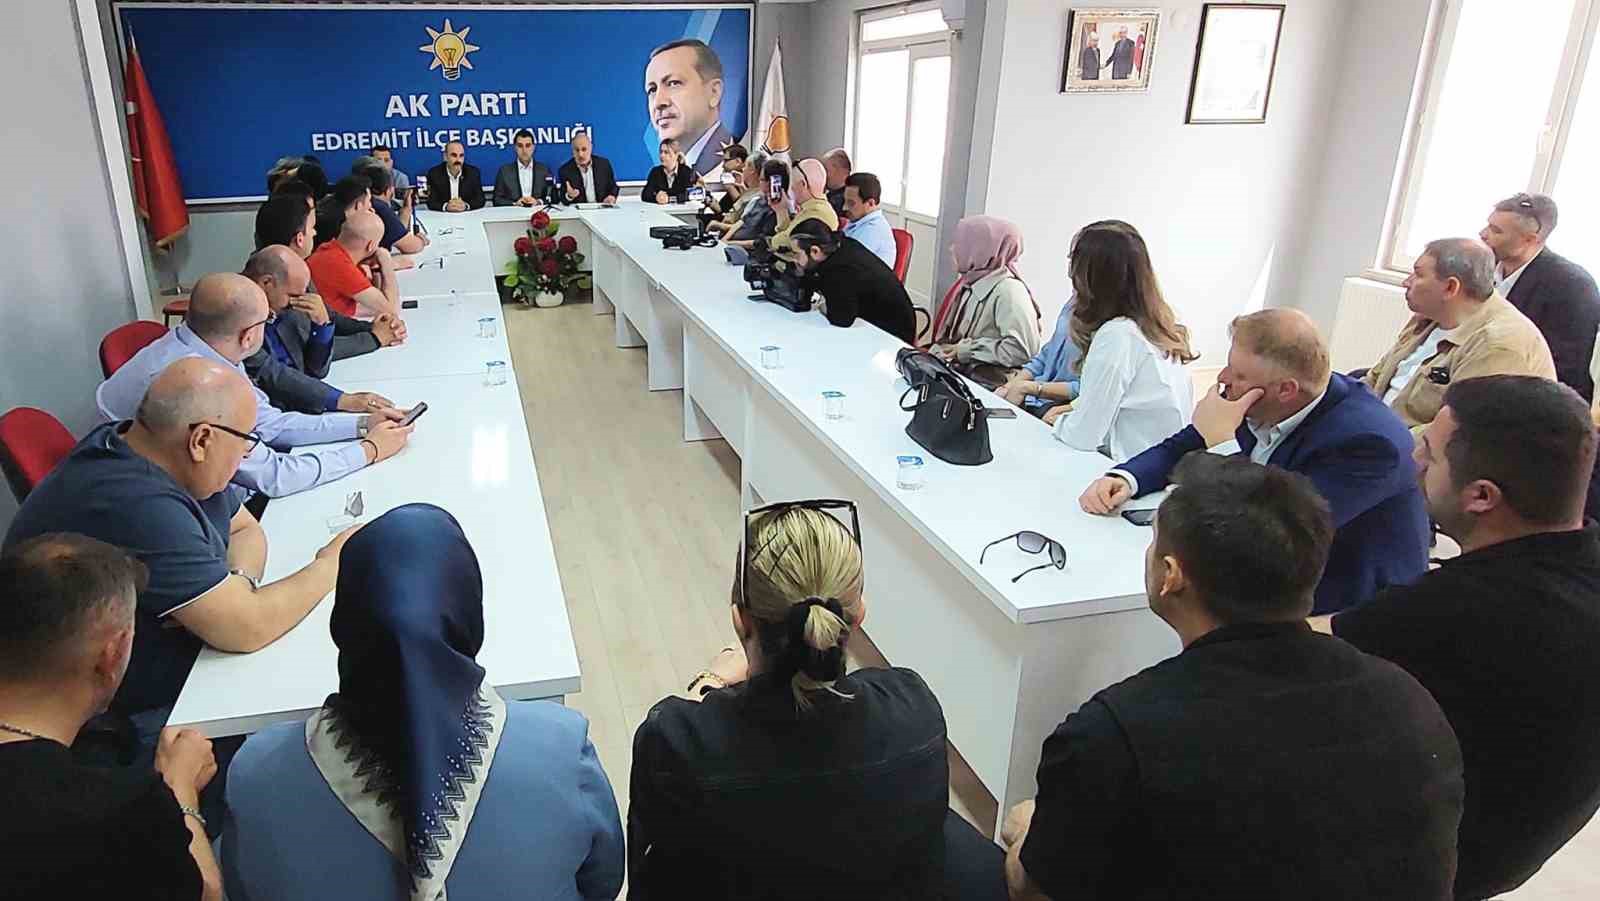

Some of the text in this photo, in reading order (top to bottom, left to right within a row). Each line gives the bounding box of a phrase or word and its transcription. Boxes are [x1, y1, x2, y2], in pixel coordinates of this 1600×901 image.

[385, 94, 431, 117] AK
[312, 128, 411, 151] EDREMİT
[416, 127, 461, 151] İLÇE
